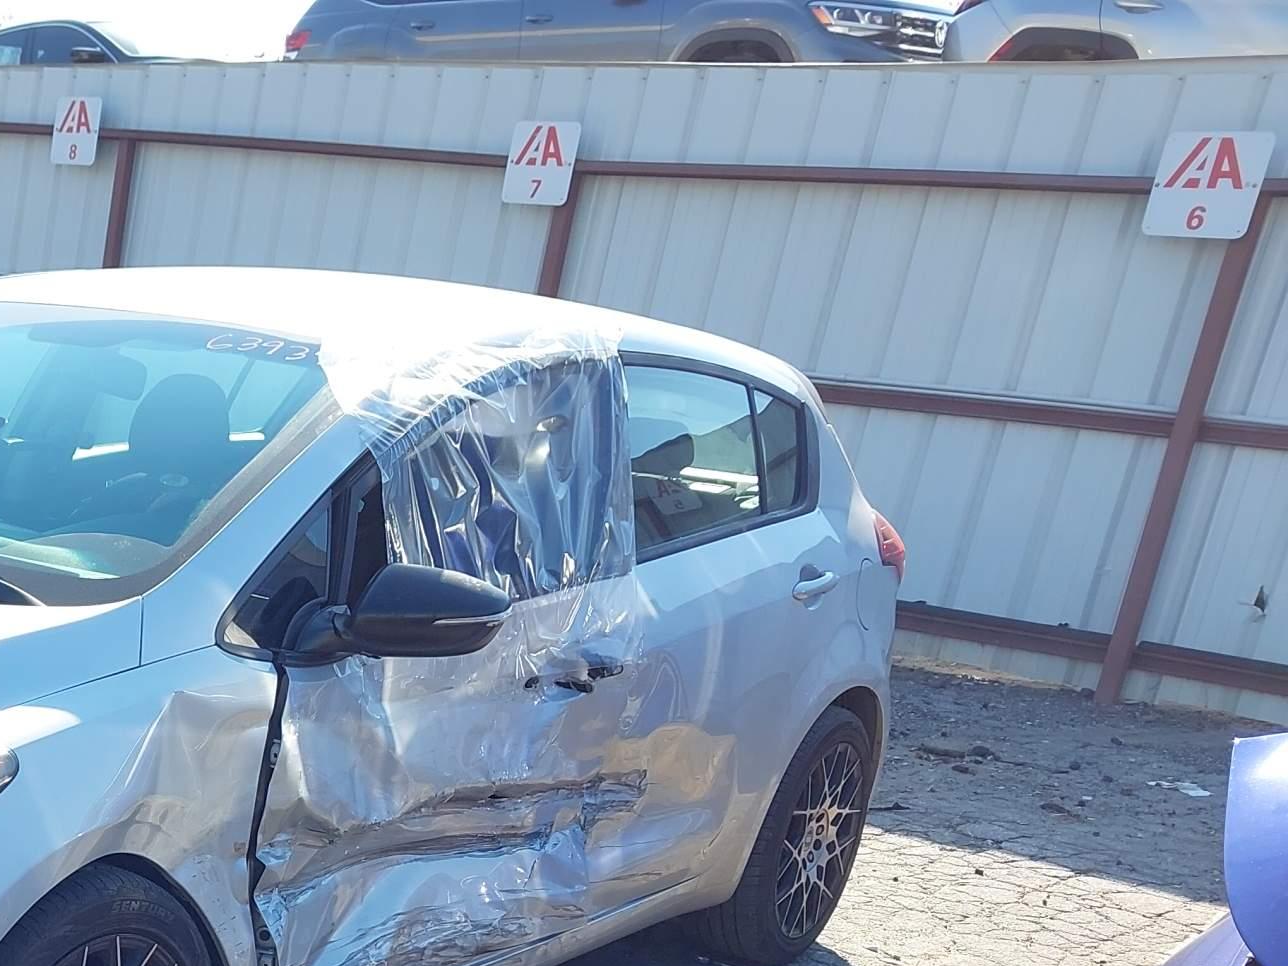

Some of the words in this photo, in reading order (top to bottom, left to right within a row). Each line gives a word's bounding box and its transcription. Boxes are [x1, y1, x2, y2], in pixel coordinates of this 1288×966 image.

[67, 144, 78, 161] 8
[530, 179, 542, 199] 7
[1185, 205, 1207, 231] 6
[206, 334, 321, 365] 6393
[111, 900, 176, 920] SENTURY
